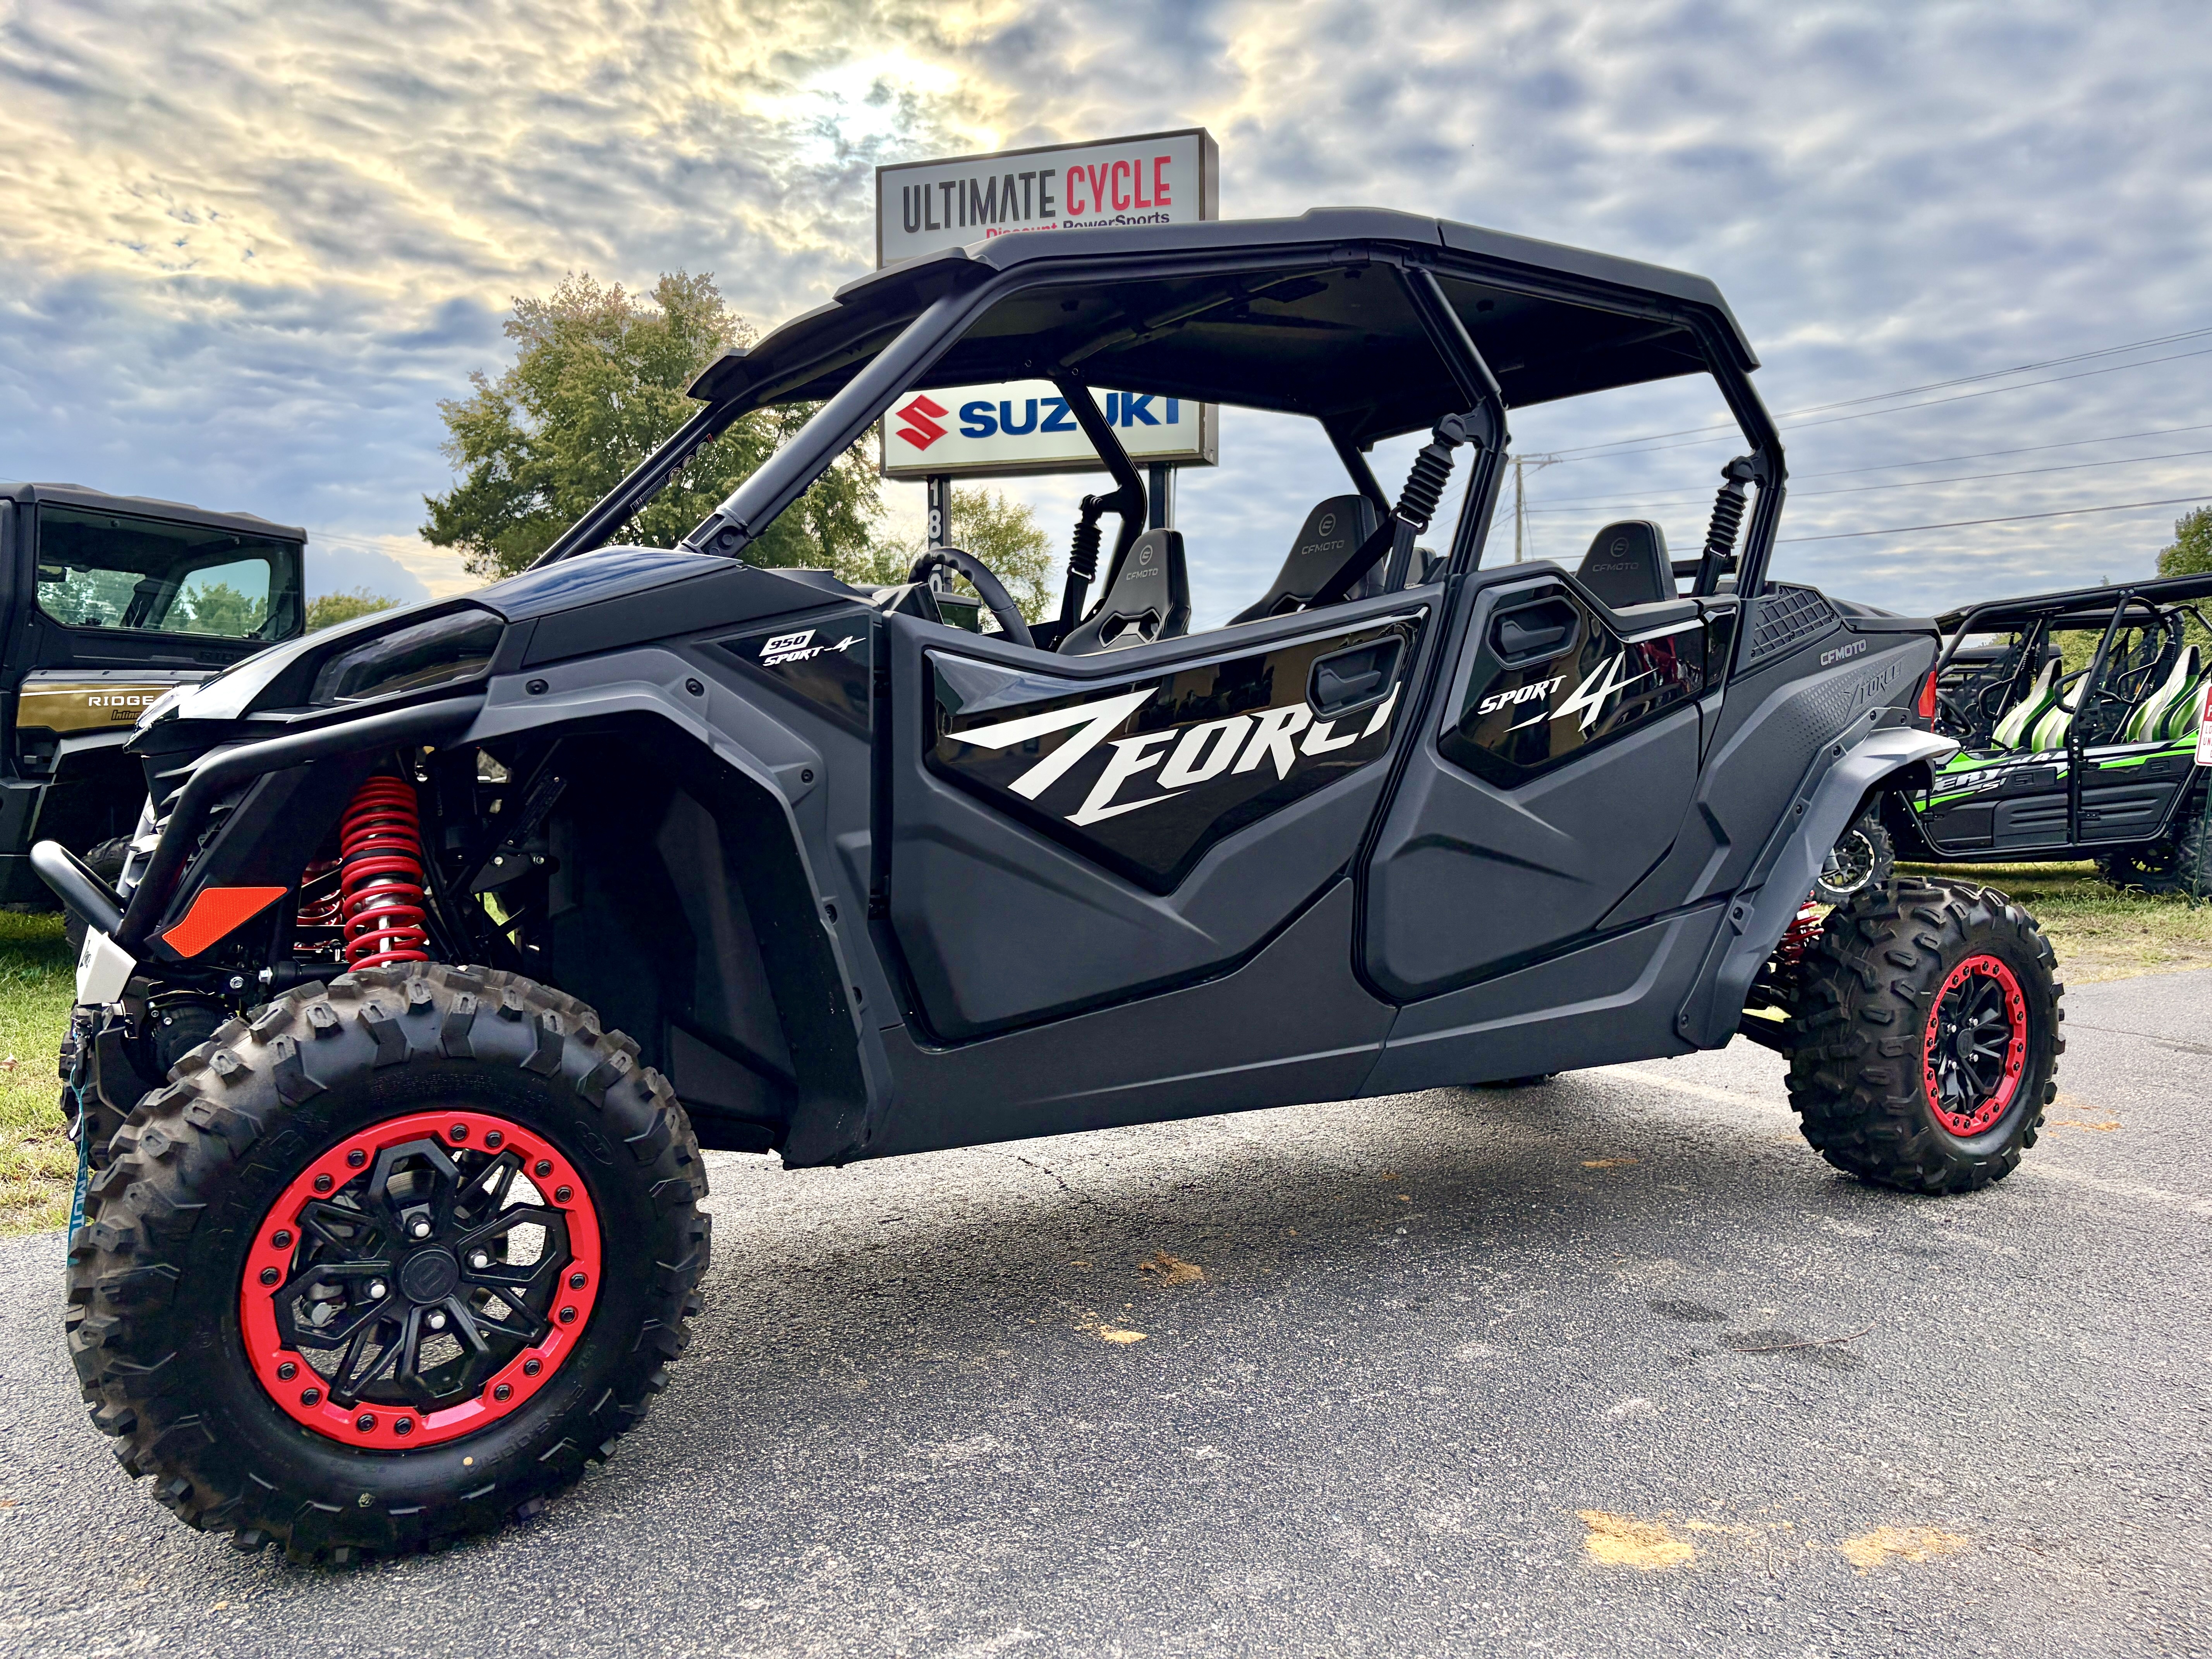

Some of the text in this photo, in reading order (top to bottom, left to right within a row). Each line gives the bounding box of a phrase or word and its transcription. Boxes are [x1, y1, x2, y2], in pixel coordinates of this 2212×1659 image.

[903, 156, 1171, 233] ULTIMATE CYCLE
[1302, 540, 1345, 555] CFMOTO
[1126, 567, 1158, 581] CFMOTO
[1592, 562, 1639, 572] CFMOTO
[770, 635, 807, 650] 950
[1820, 639, 1867, 666] CFMOTO
[1477, 650, 1659, 732] SPORT 4
[89, 696, 154, 706] RIDGE
